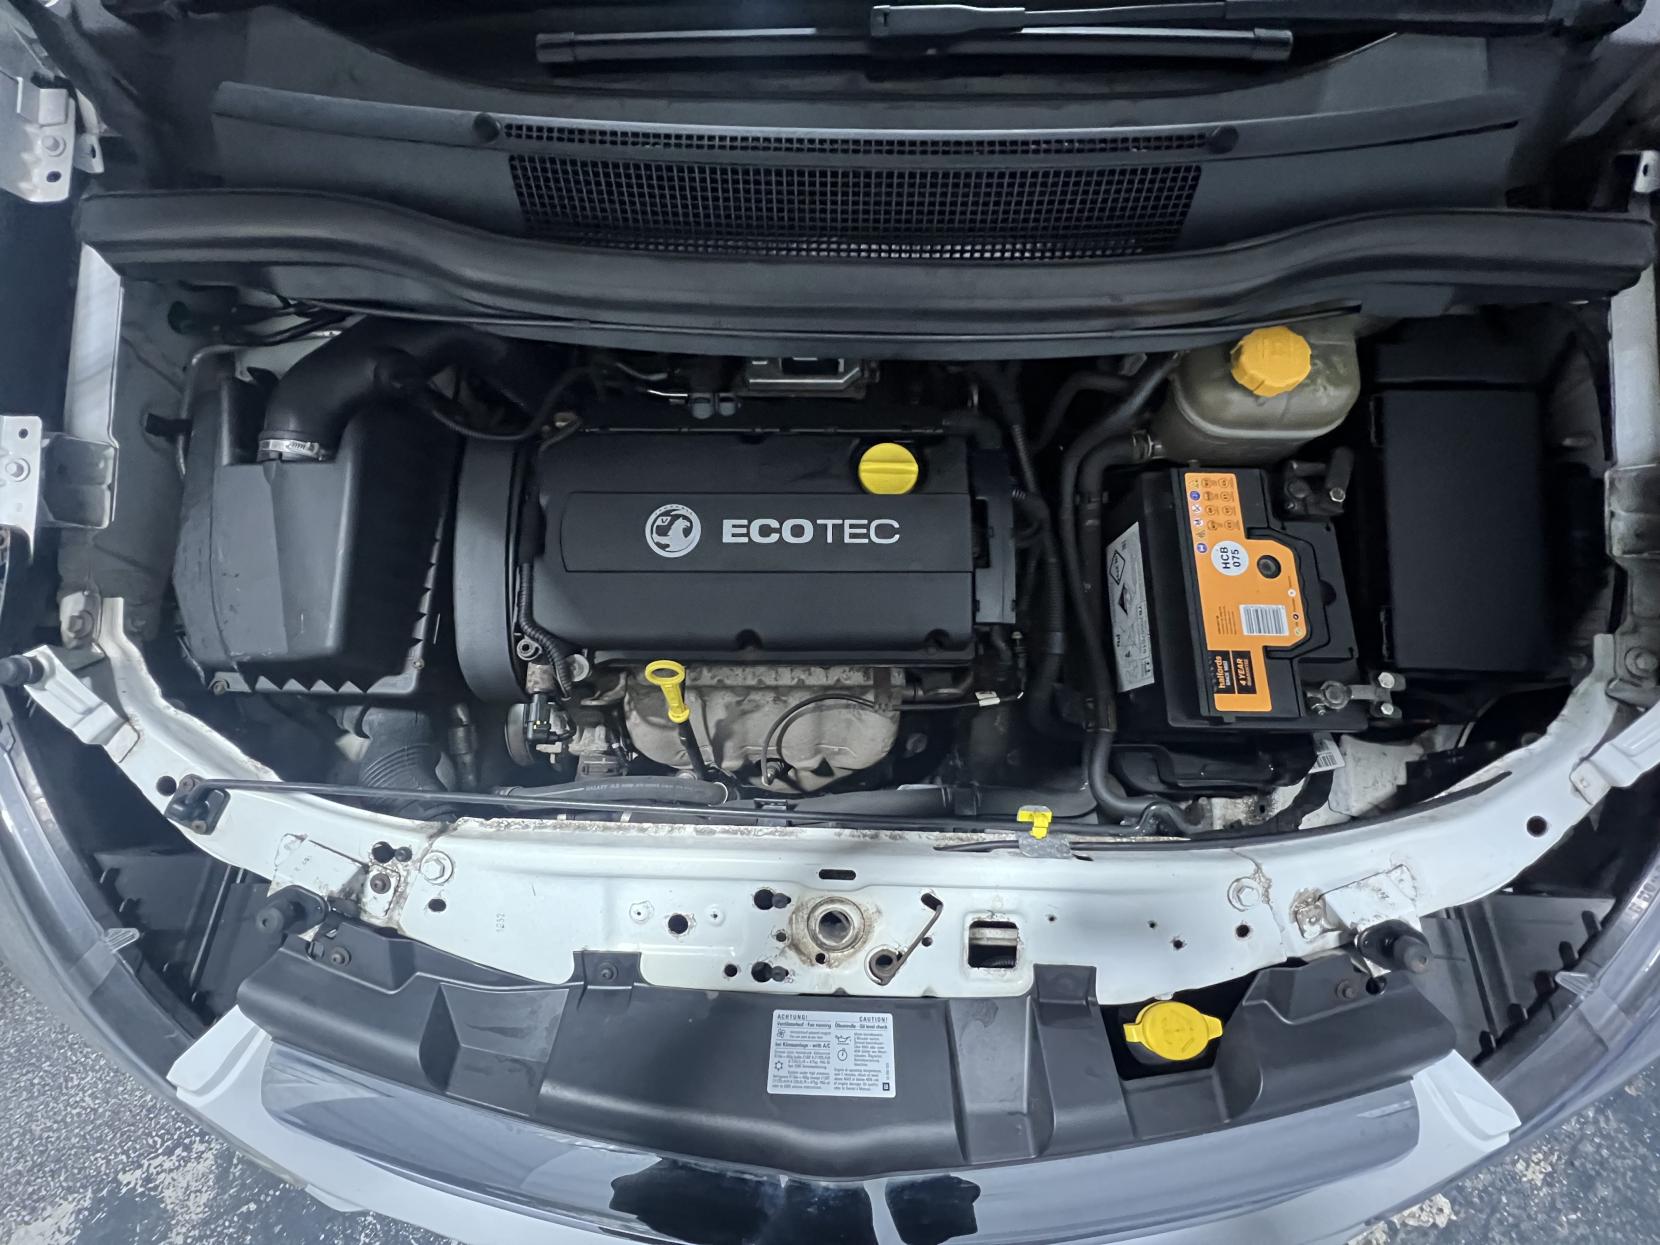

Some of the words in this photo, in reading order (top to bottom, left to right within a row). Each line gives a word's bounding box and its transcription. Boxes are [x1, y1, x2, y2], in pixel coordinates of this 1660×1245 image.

[722, 518, 900, 544] ECOTEC
[1219, 546, 1231, 570] HCB
[1231, 549, 1242, 568] 075
[1215, 655, 1226, 689] halfords
[1236, 658, 1246, 680] YEAR
[777, 1013, 808, 1021] ACHTUNG!
